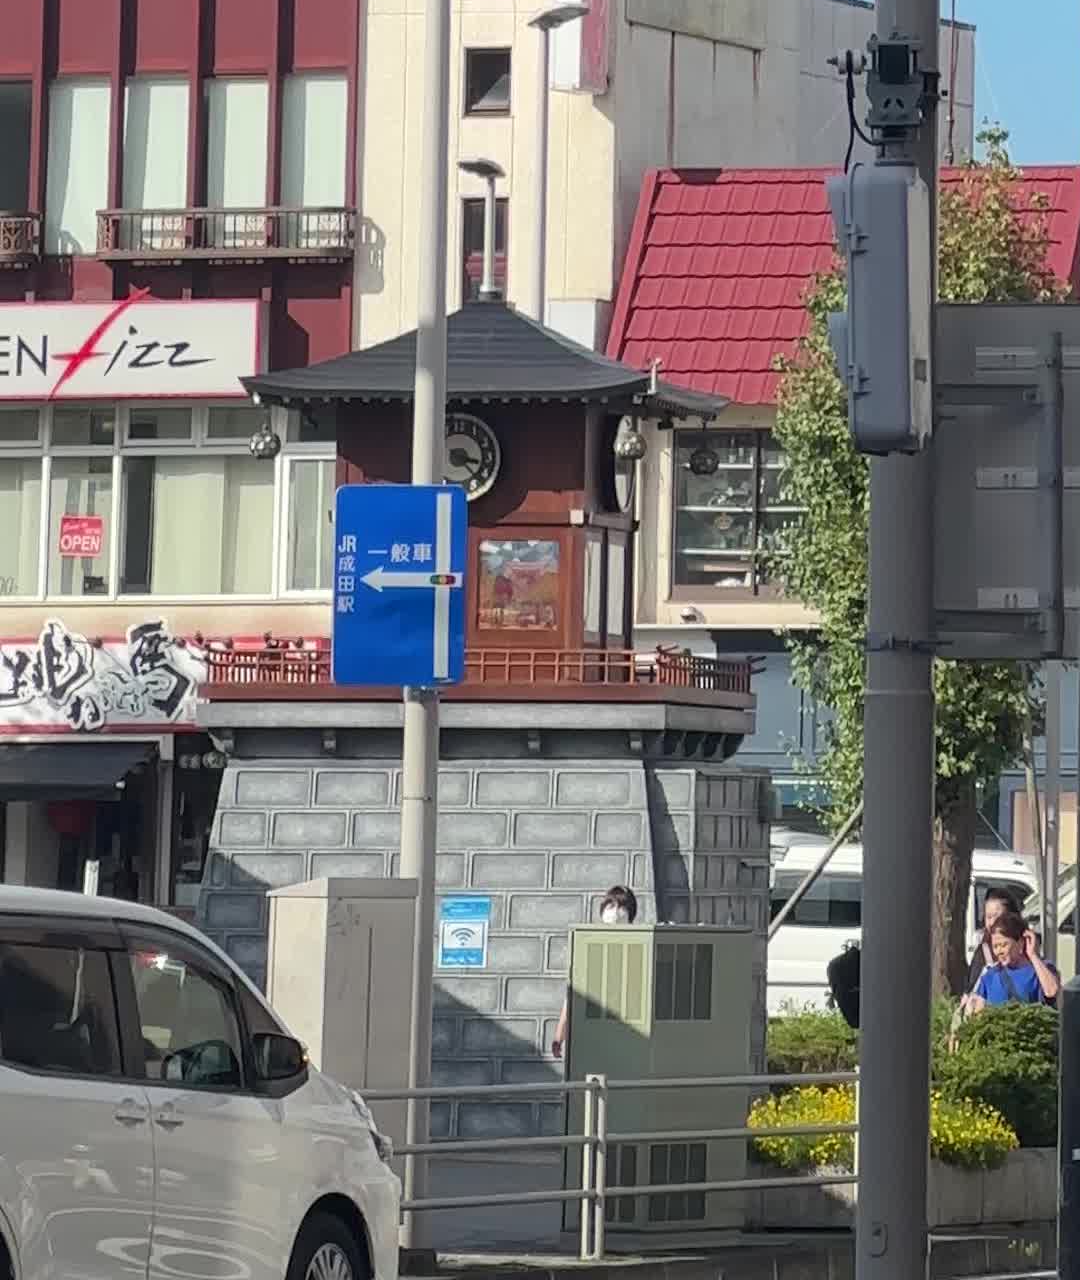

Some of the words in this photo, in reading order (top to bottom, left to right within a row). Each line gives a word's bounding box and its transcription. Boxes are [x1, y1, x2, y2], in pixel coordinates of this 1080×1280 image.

[61, 535, 100, 551] OPEN
[368, 543, 432, 564] 一般車
